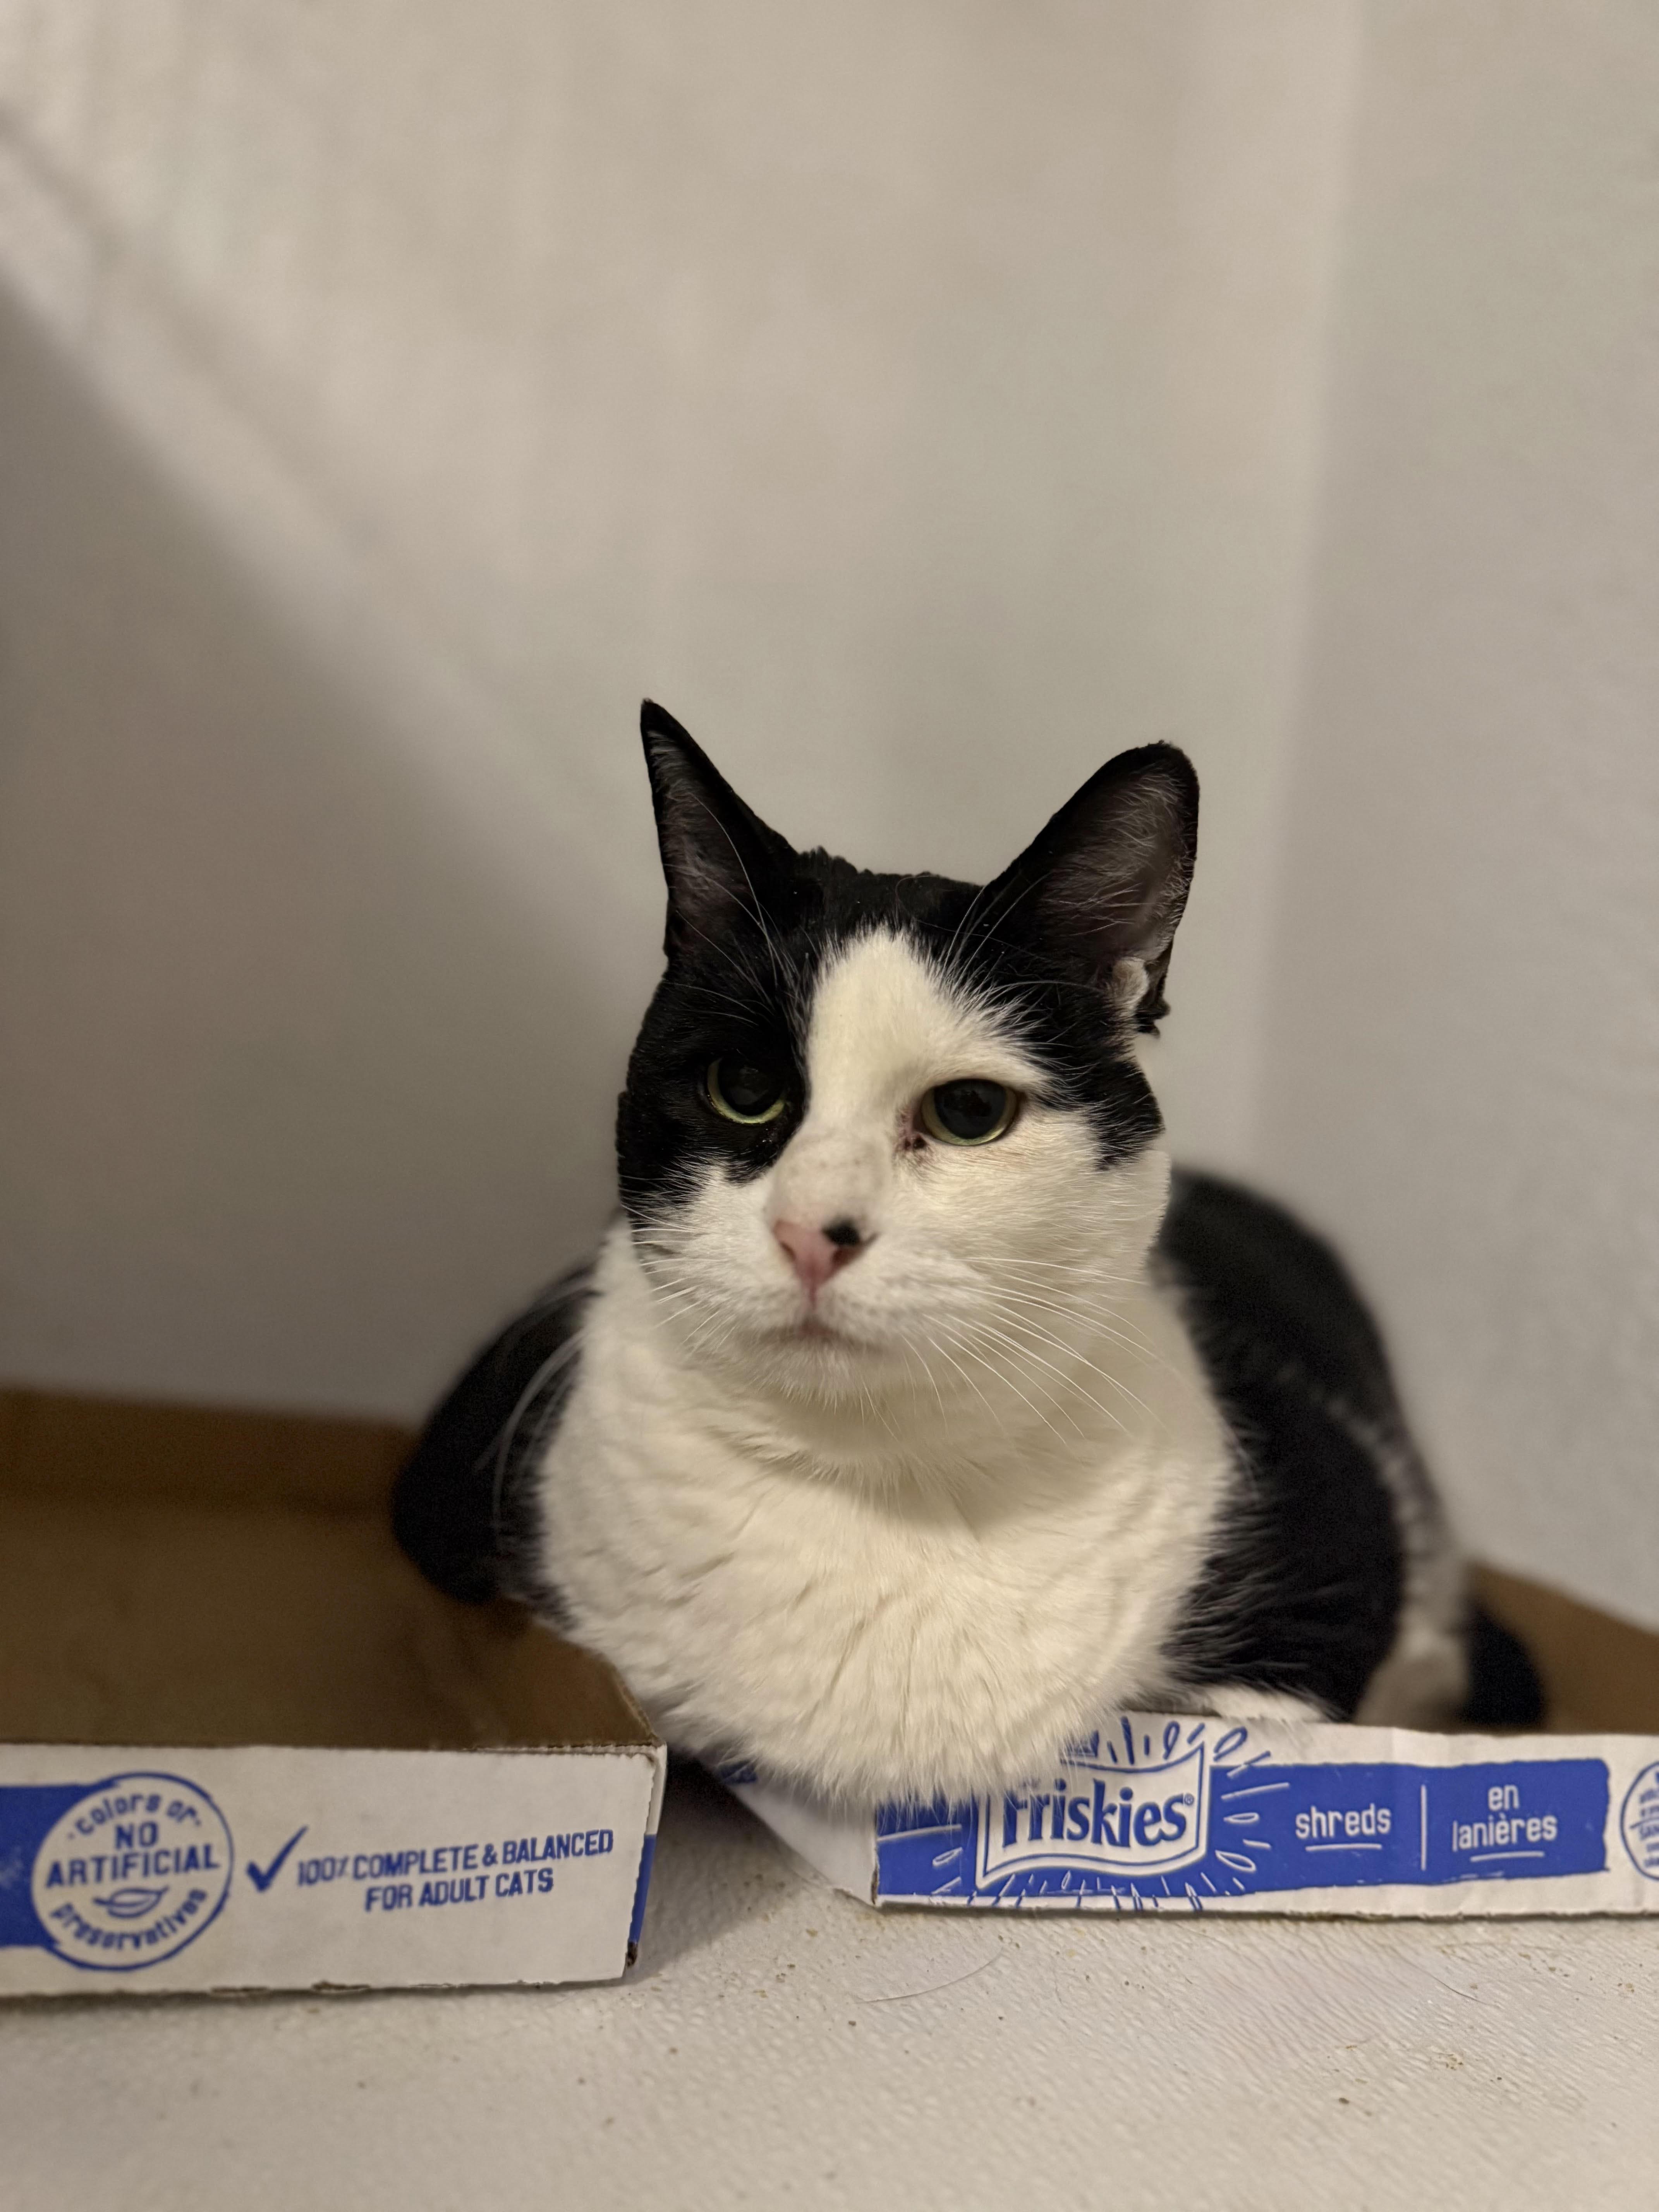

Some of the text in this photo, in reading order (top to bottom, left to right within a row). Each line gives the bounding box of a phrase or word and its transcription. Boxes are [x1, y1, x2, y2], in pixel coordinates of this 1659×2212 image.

[75, 1794, 196, 1834] colors or
[1488, 1784, 1519, 1811] en
[114, 1821, 159, 1850] NO
[1295, 1803, 1391, 1839] shreds
[1453, 1814, 1558, 1852] lanières
[46, 1844, 220, 1888] ARTIFICIAL
[353, 1844, 479, 1881] COMPLETE
[483, 1843, 498, 1865] &
[502, 1829, 613, 1865] BALANCED
[365, 1867, 554, 1912] FOR ADULT CATS
